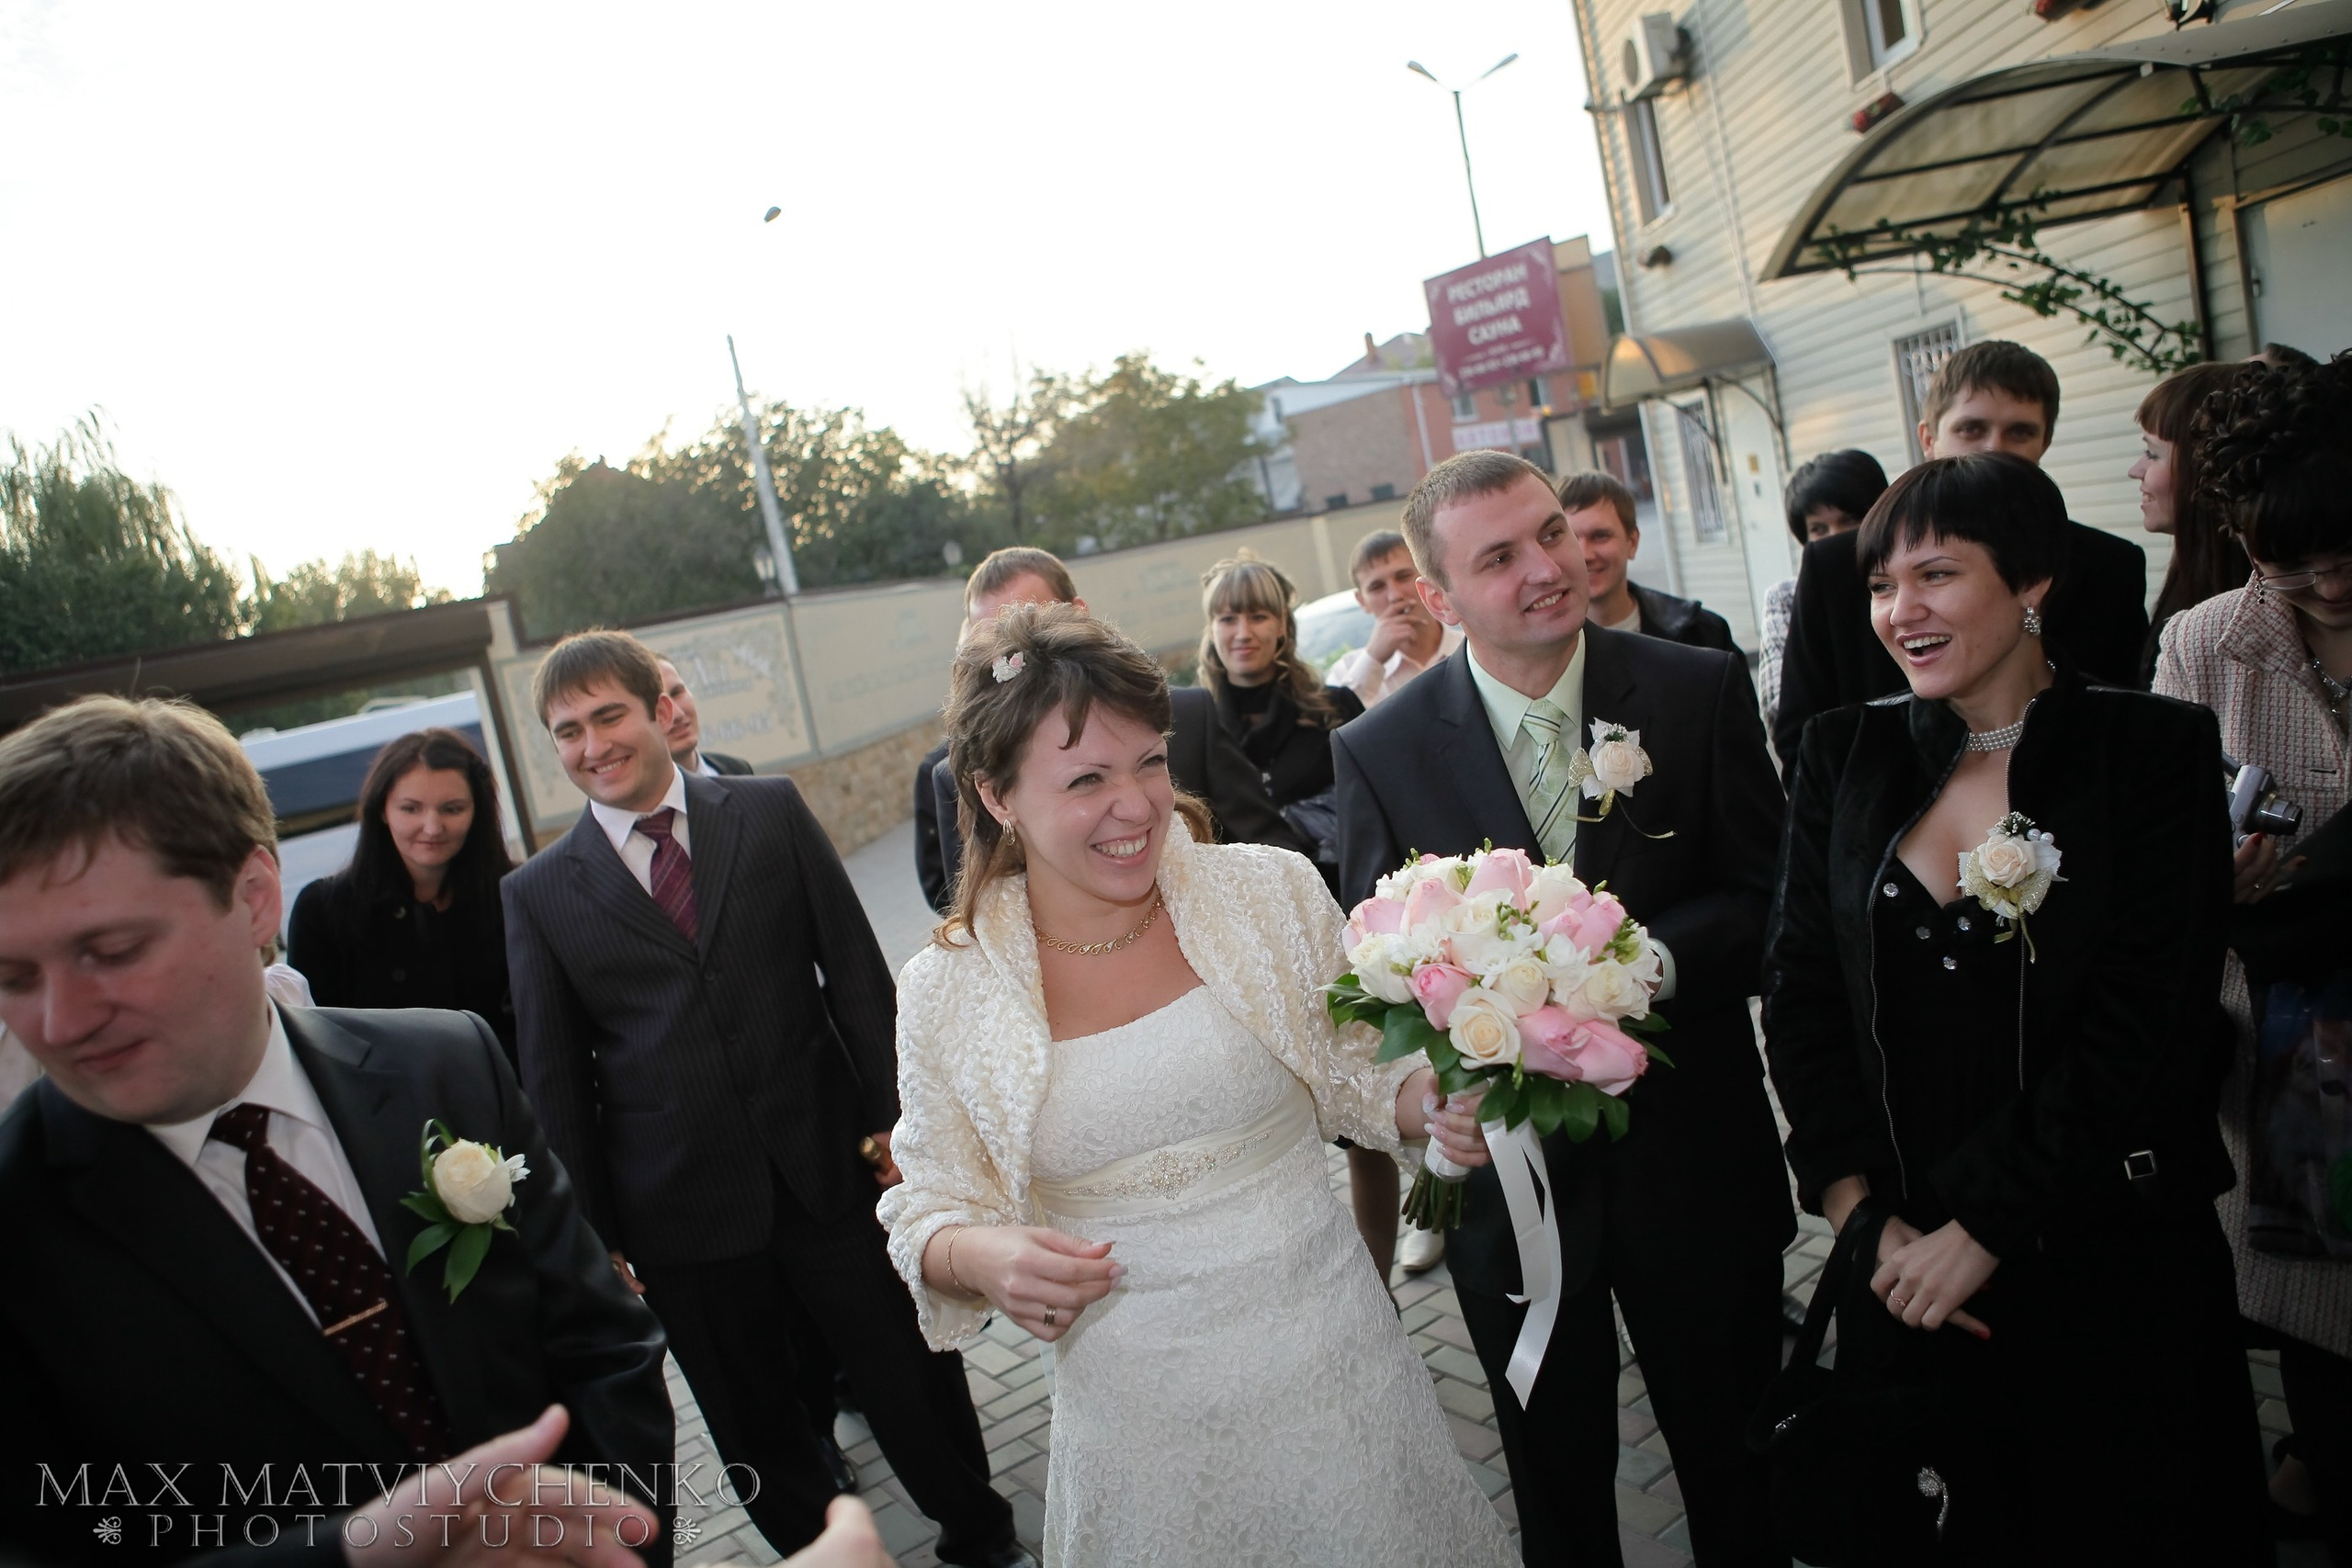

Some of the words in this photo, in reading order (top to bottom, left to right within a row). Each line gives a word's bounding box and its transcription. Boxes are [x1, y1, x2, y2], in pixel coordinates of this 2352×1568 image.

[1447, 264, 1528, 303] РЕСТОРАН
[1453, 287, 1531, 326] БИЛЬЯРД
[1468, 315, 1522, 345] САУНА
